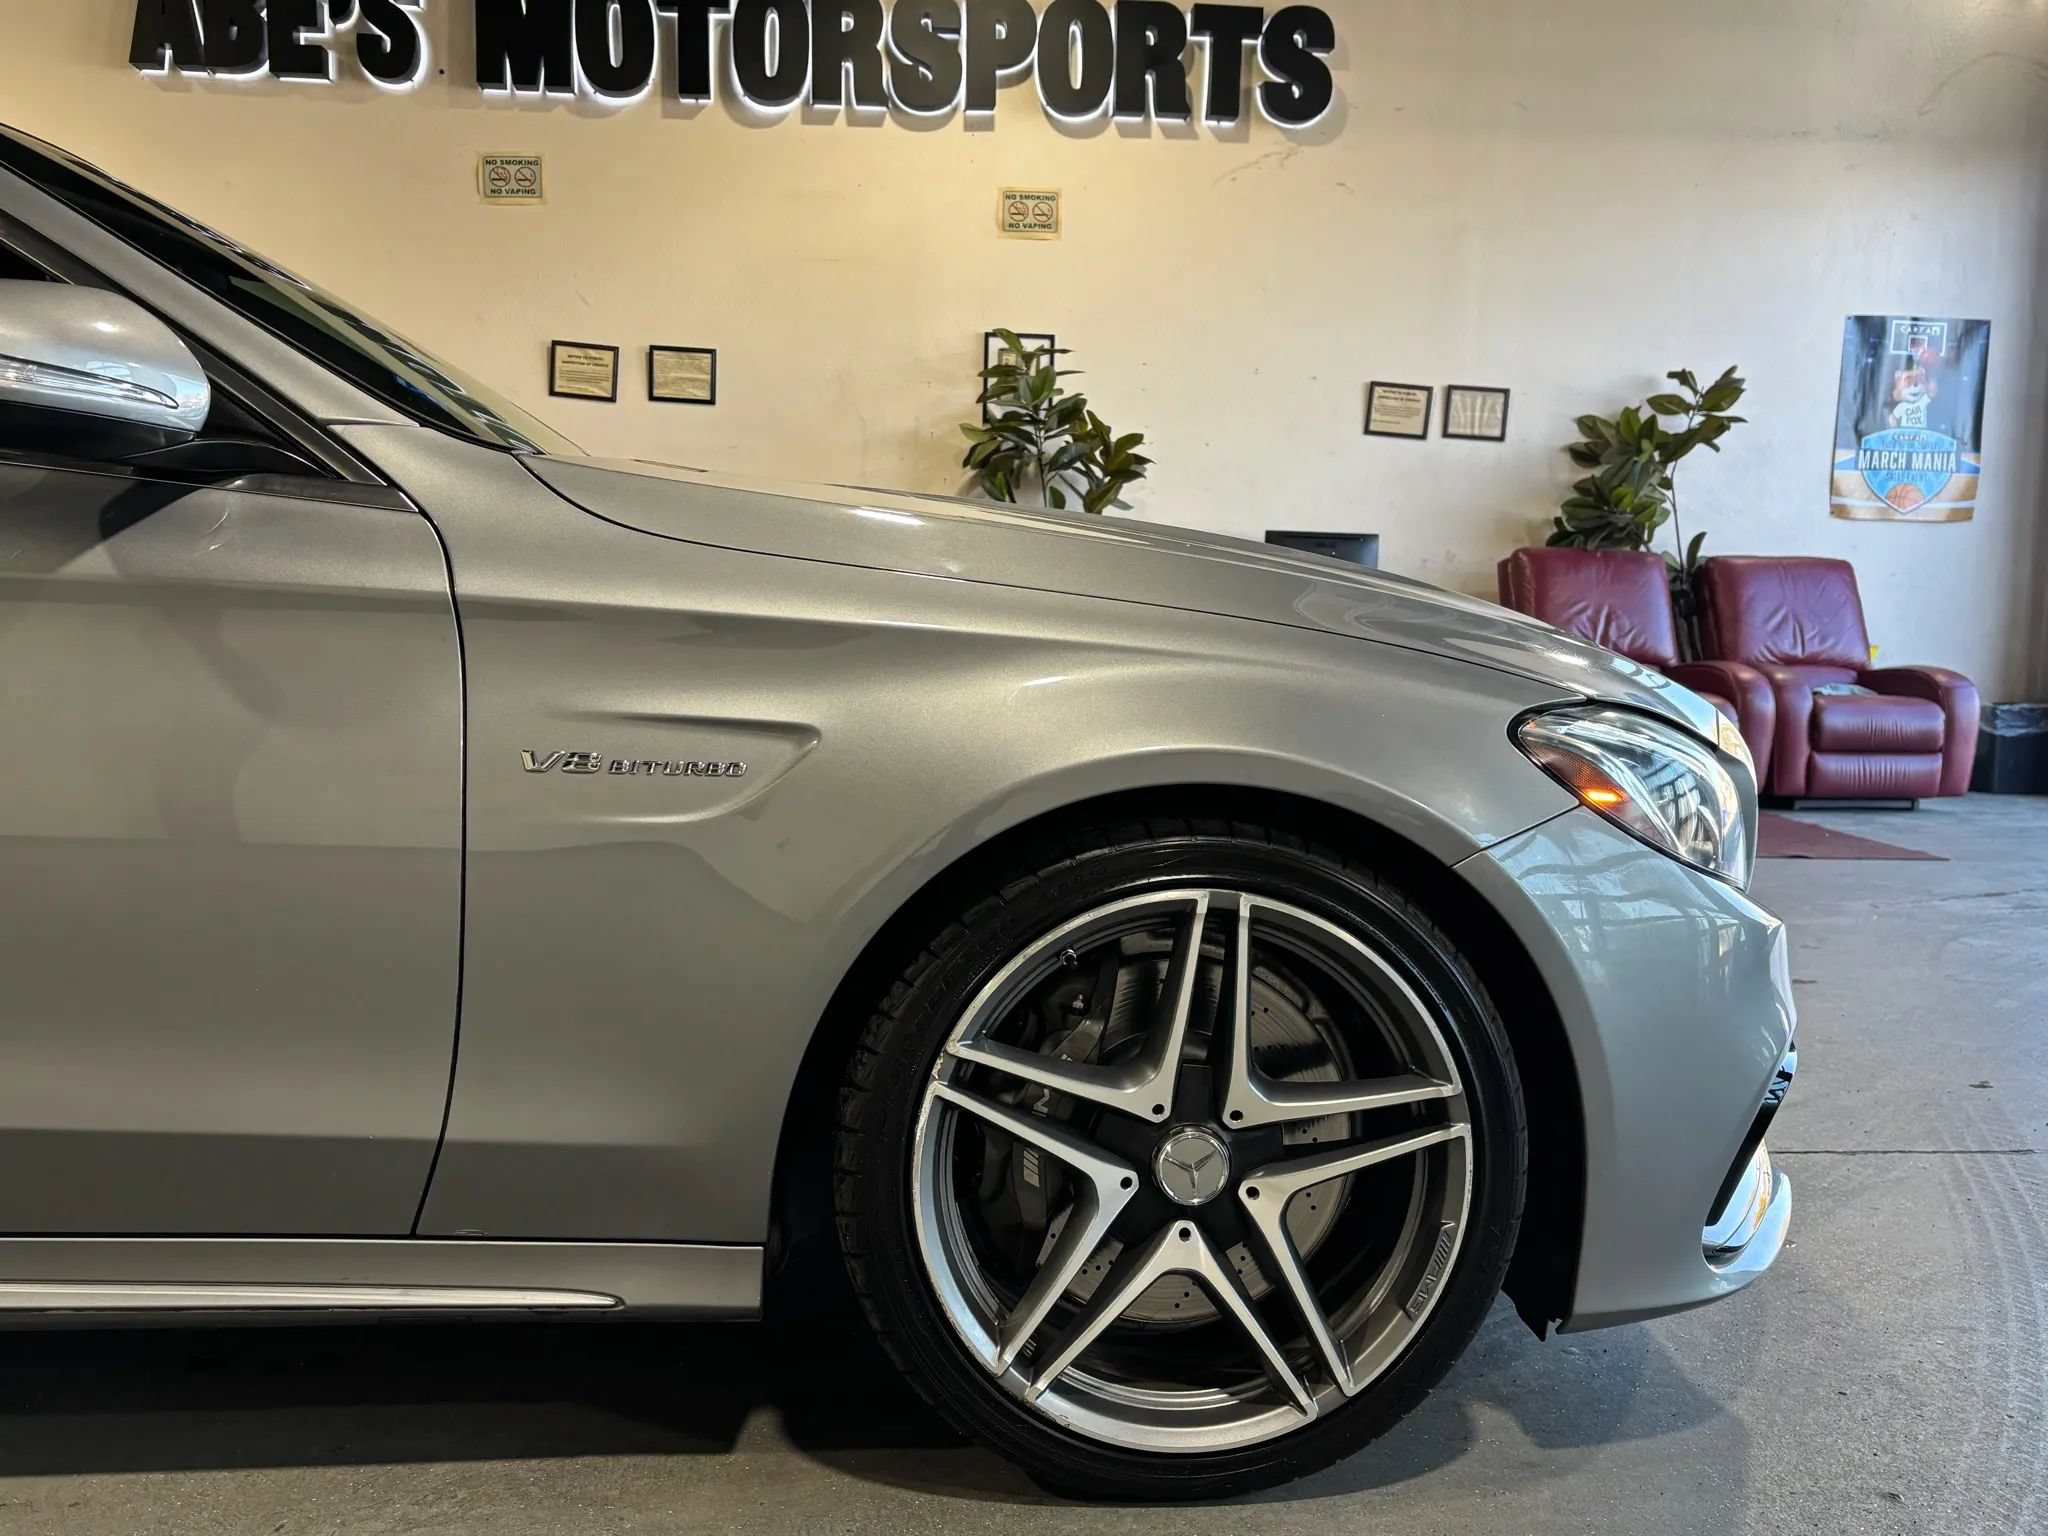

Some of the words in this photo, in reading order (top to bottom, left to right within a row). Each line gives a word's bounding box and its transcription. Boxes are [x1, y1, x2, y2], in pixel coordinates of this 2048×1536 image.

[475, 0, 1337, 131] MOTORSPORTS
[1022, 222, 1053, 230] VAPING
[1859, 450, 1906, 470] MARCH
[1911, 452, 1956, 472] MANIA
[520, 749, 602, 775] V8
[608, 759, 748, 777] BITURBO
